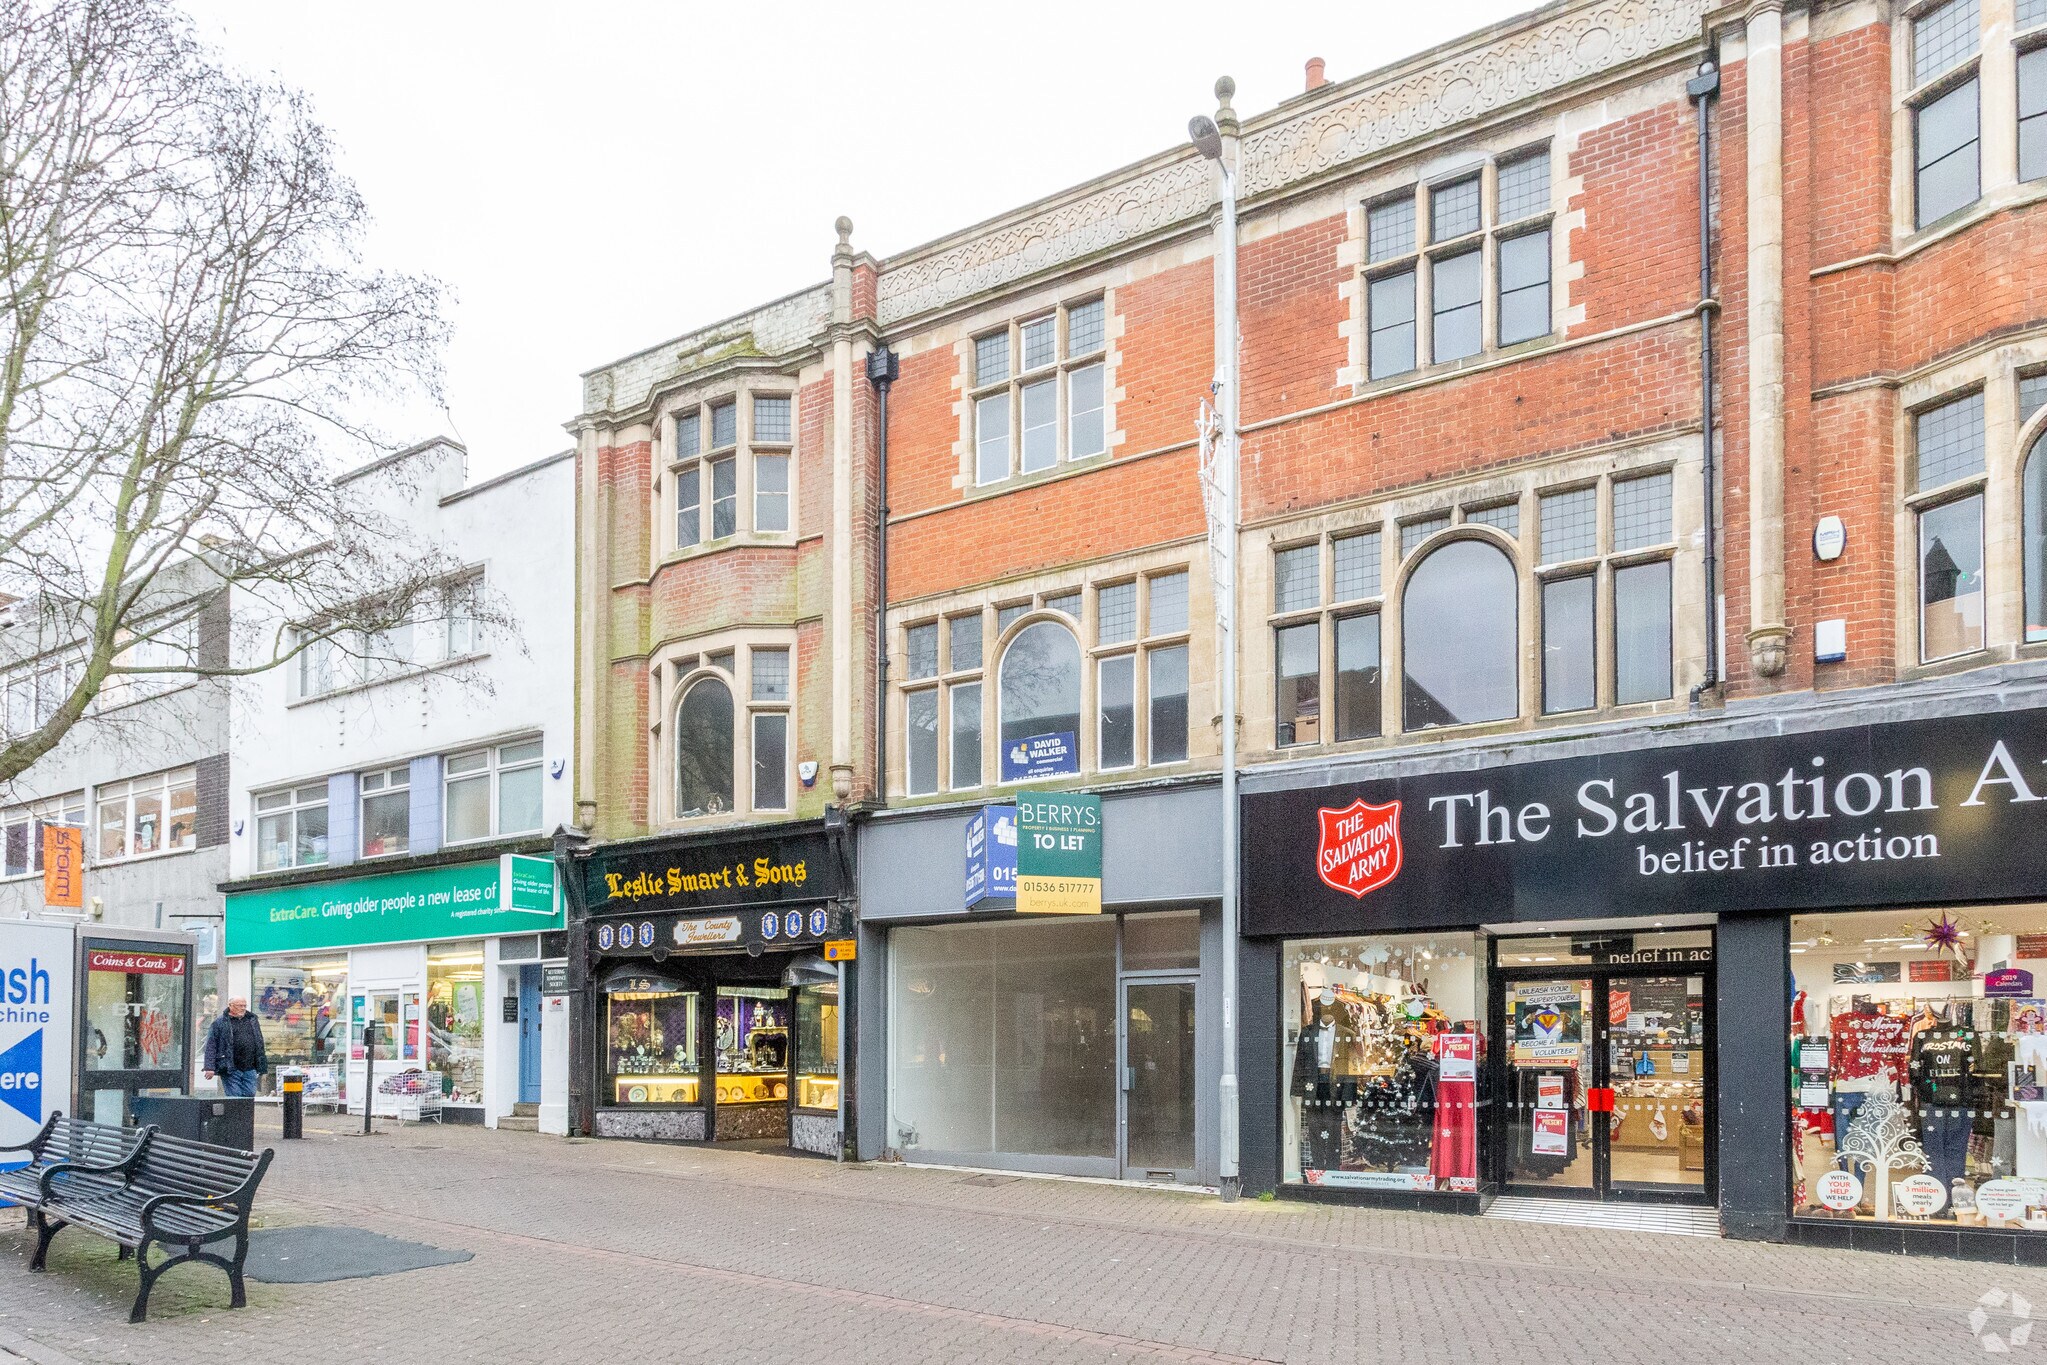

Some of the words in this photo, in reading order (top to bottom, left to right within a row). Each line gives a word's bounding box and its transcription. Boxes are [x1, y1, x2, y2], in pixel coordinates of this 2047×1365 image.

[1034, 738, 1061, 749] DAVID
[1030, 746, 1067, 758] WALKER
[1428, 790, 1551, 848] The
[1577, 756, 1939, 839] Salvation
[1960, 740, 2047, 806] A
[1022, 803, 1095, 825] BERRYS
[1336, 812, 1364, 840] THE
[1033, 834, 1055, 849] TO
[1060, 835, 1084, 850] LET
[1323, 815, 1393, 873] SALVATION
[1636, 836, 1750, 876] belief
[1759, 836, 1795, 868] in
[1809, 827, 1941, 866] action
[56, 831, 72, 897] storm
[1348, 843, 1390, 885] ARMY
[605, 872, 664, 902] Leslie
[666, 866, 732, 896] Smart
[736, 863, 750, 887] &
[753, 857, 807, 888] Sons
[1024, 882, 1056, 893] 01536
[1059, 883, 1094, 893] 517777
[270, 906, 319, 922] ExtraCare.
[322, 900, 353, 919] Giving
[353, 896, 379, 913] older
[381, 892, 416, 915] people
[418, 895, 425, 906] a
[428, 891, 450, 905] new
[453, 886, 481, 903] lease
[484, 882, 497, 899] of
[1030, 897, 1089, 909] berrys.uk.com
[455, 909, 477, 919] registered
[478, 908, 493, 916] charity
[682, 922, 698, 931] The
[704, 920, 733, 931] County
[685, 931, 726, 943] Jewellers
[93, 955, 124, 967] Coins
[125, 956, 134, 967] &
[135, 957, 167, 969] Cards
[1689, 949, 1713, 961] ac
[1519, 987, 1549, 995] UNLEASH
[112, 1002, 146, 1017] BT
[1863, 1016, 1903, 1036] Merry
[1859, 1039, 1908, 1054] Christmas
[1936, 1054, 1950, 1064] ON
[1331, 1174, 1406, 1184] www.salvationarmytrading.org
